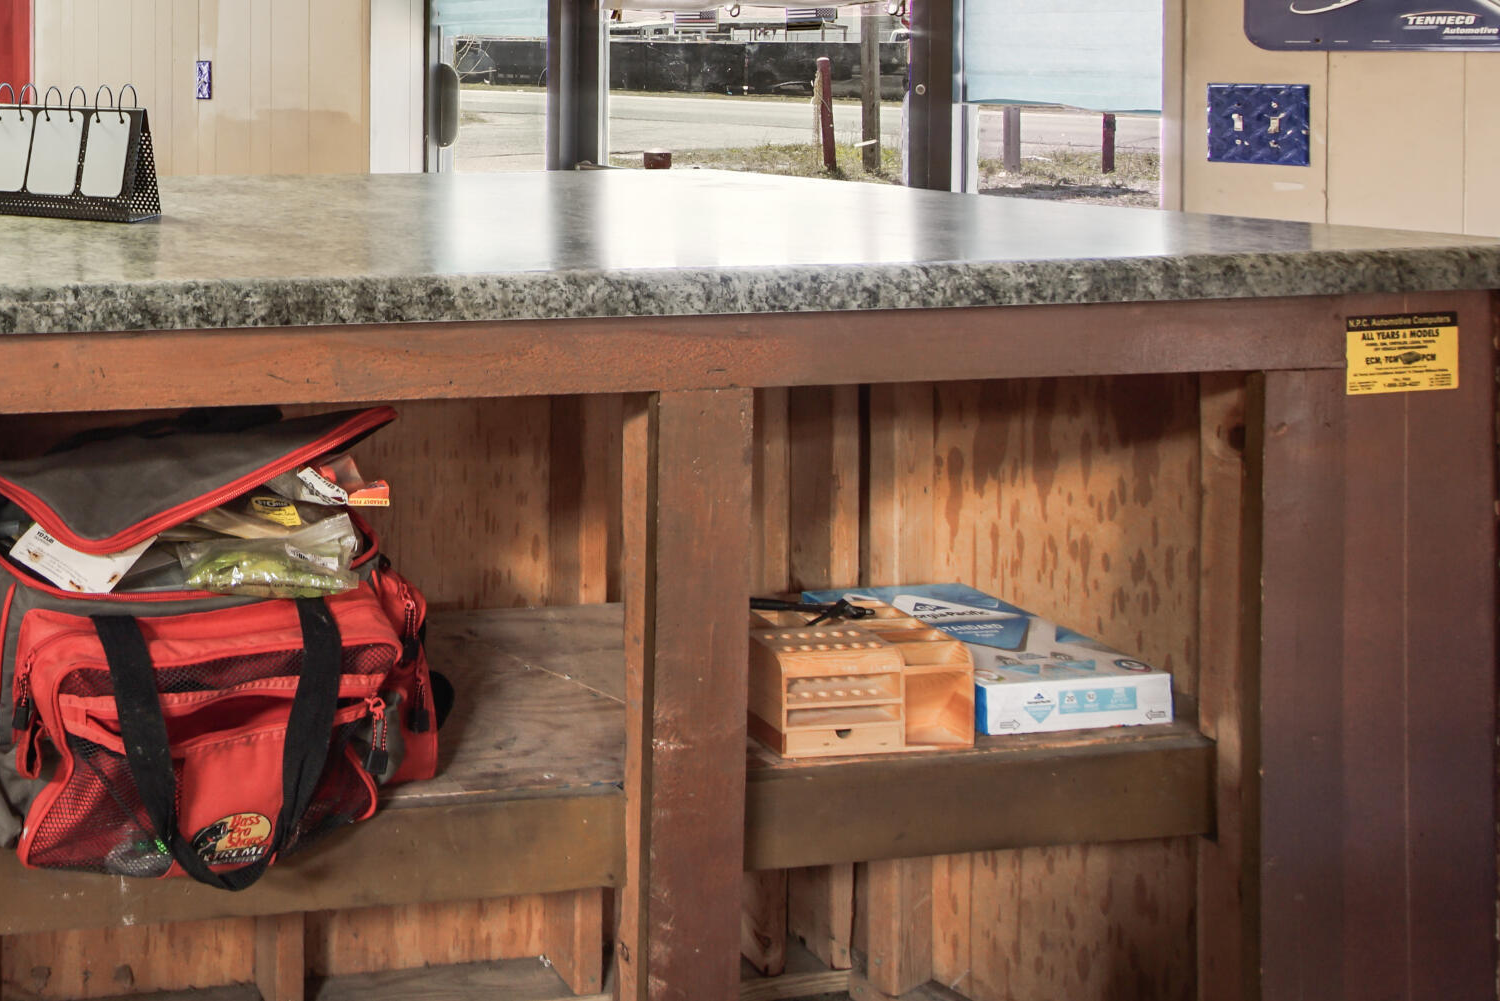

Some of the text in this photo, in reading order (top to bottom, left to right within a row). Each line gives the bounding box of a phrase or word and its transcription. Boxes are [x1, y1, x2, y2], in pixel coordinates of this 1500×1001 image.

[1407, 15, 1477, 26] TENNECO
[1442, 26, 1499, 35] Automotive
[1361, 332, 1375, 341] ALL
[1376, 331, 1400, 340] YEARS
[1409, 328, 1440, 339] MODELS
[229, 815, 261, 828] Bass
